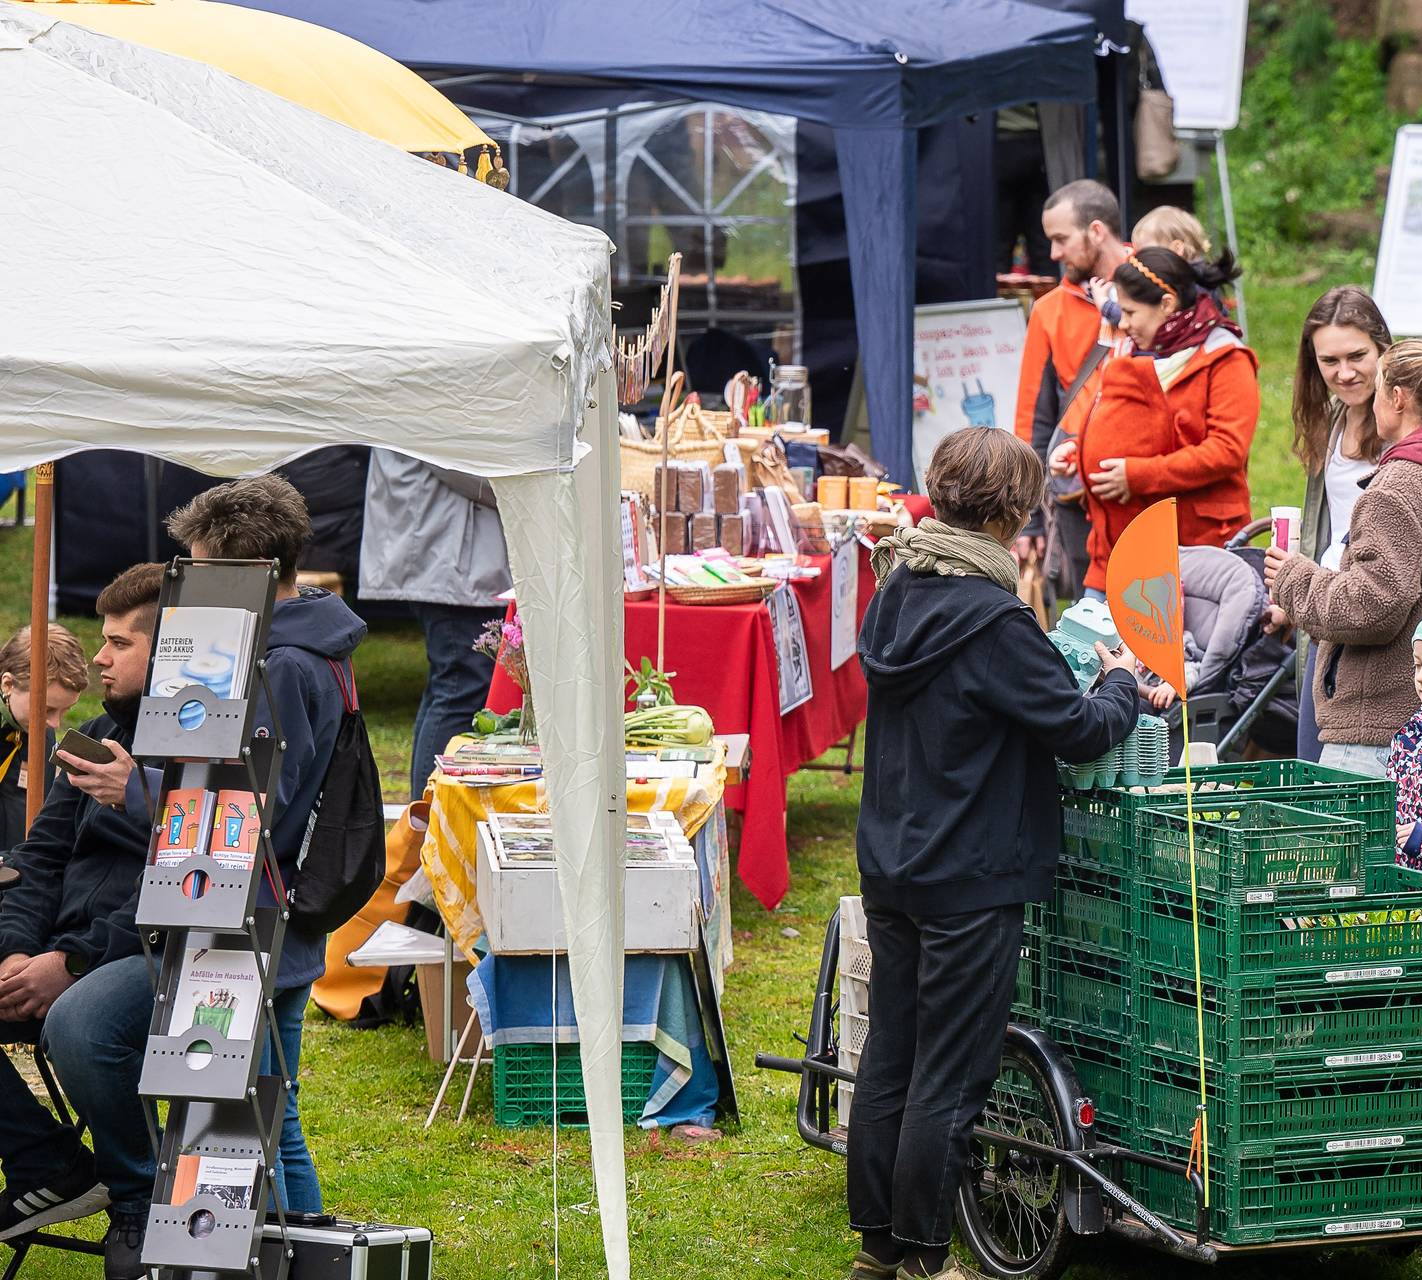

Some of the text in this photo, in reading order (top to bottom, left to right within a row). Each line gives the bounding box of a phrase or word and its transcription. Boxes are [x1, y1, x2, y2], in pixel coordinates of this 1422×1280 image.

[160, 637, 193, 645] BATTERIEN
[190, 970, 254, 981] Abfälle im Haushalt
[1103, 1181, 1160, 1229] CARLA CARGO
